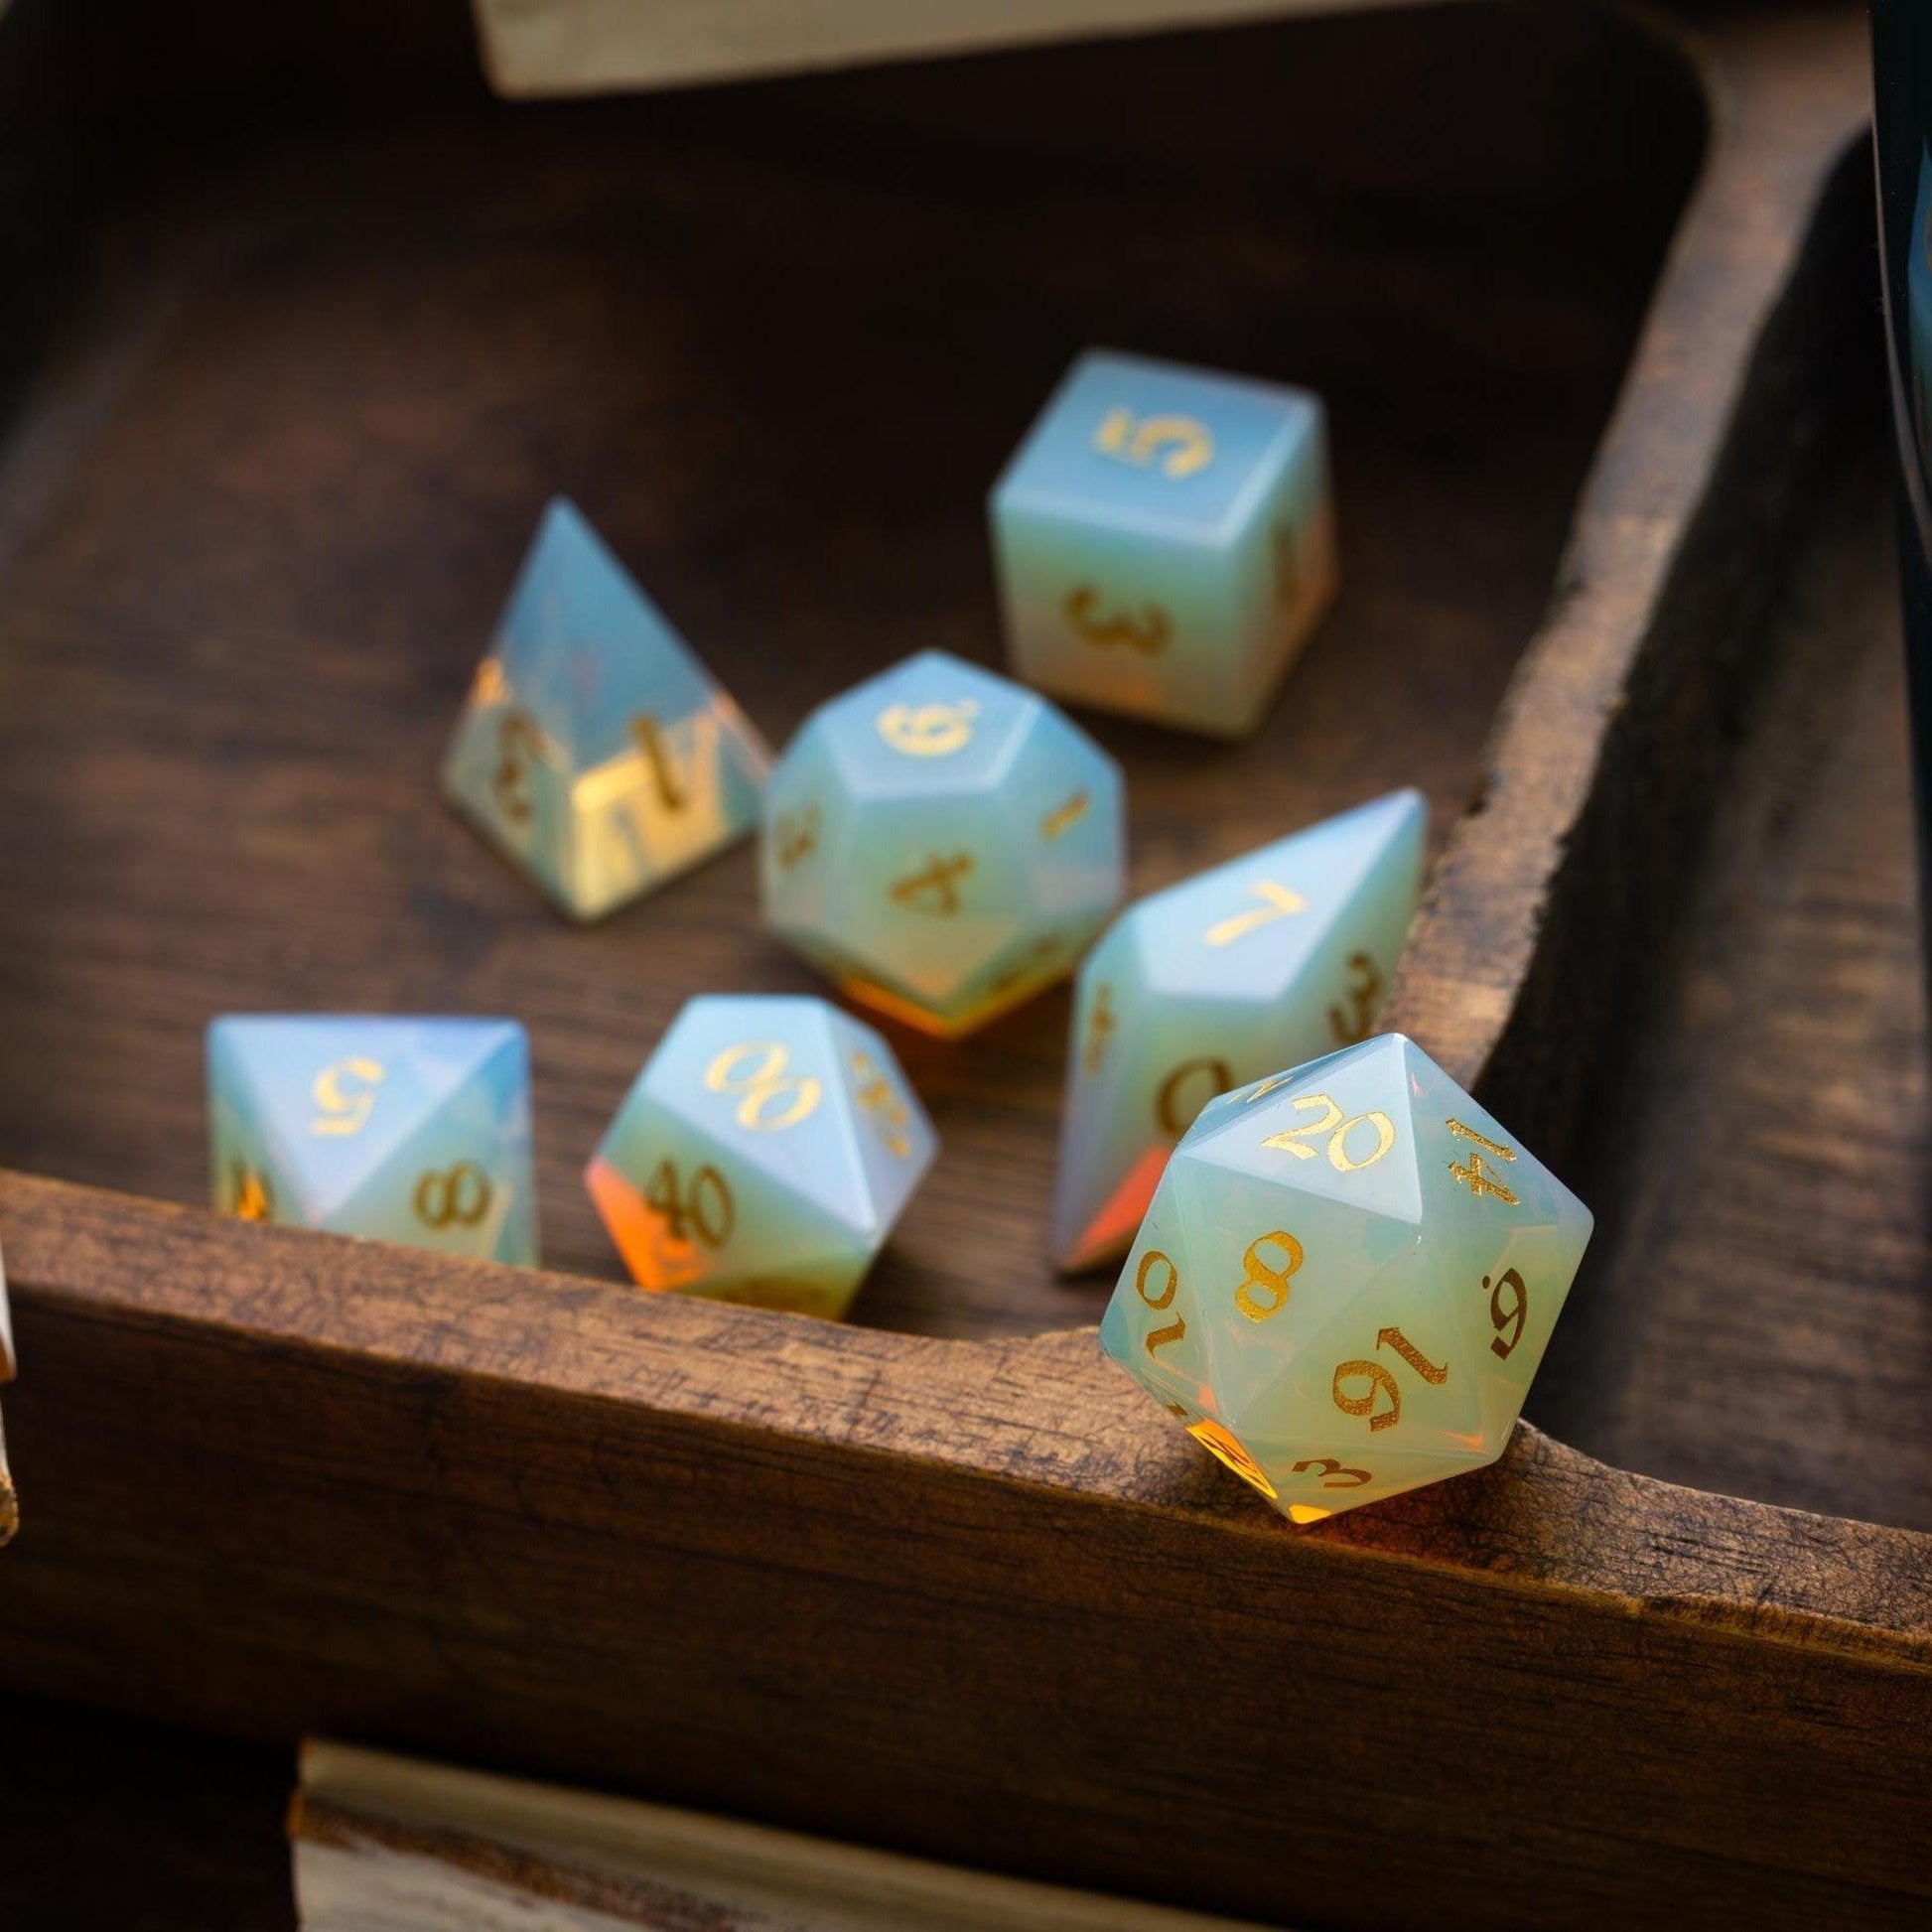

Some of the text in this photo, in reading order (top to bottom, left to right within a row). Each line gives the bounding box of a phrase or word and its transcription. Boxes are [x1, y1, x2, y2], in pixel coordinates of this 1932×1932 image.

[1095, 408, 1214, 479] 5
[1064, 583, 1173, 657] 3
[1205, 882, 1308, 946] 7
[1330, 952, 1381, 1044] 3
[311, 1057, 387, 1138] 5
[703, 1039, 823, 1133] 00
[1261, 1092, 1397, 1173] 20
[1446, 1118, 1521, 1205] 14
[412, 1160, 493, 1231] 8
[646, 1158, 735, 1250] 40
[1136, 1250, 1186, 1360] 10
[1235, 1230, 1304, 1323] 8
[1332, 1326, 1449, 1433] 16
[1293, 1458, 1373, 1488] 3
